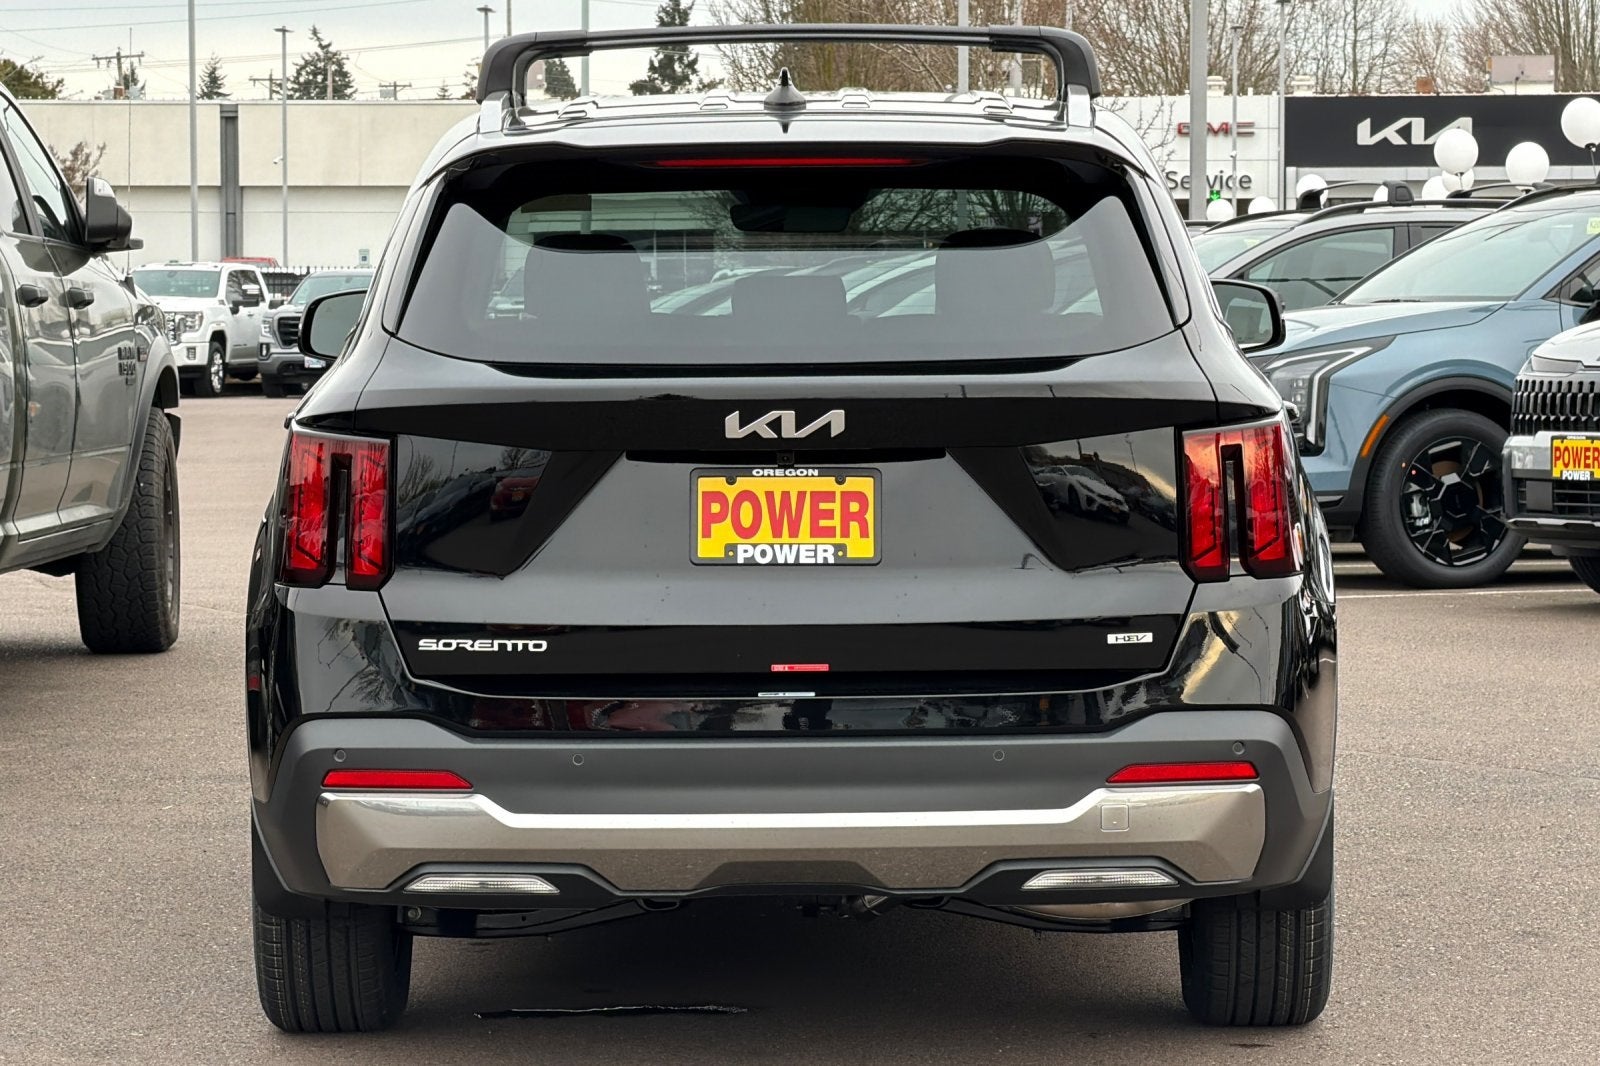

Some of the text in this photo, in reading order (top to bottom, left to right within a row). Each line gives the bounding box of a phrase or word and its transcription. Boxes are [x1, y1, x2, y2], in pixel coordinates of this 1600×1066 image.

[1166, 170, 1252, 190] Sevice
[725, 409, 845, 438] KIA
[1554, 446, 1600, 469] POWER
[752, 468, 819, 477] OREGON
[1562, 471, 1590, 480] POWER
[701, 490, 870, 539] POWER
[737, 544, 835, 563] POWER
[418, 639, 548, 651] SORENTO
